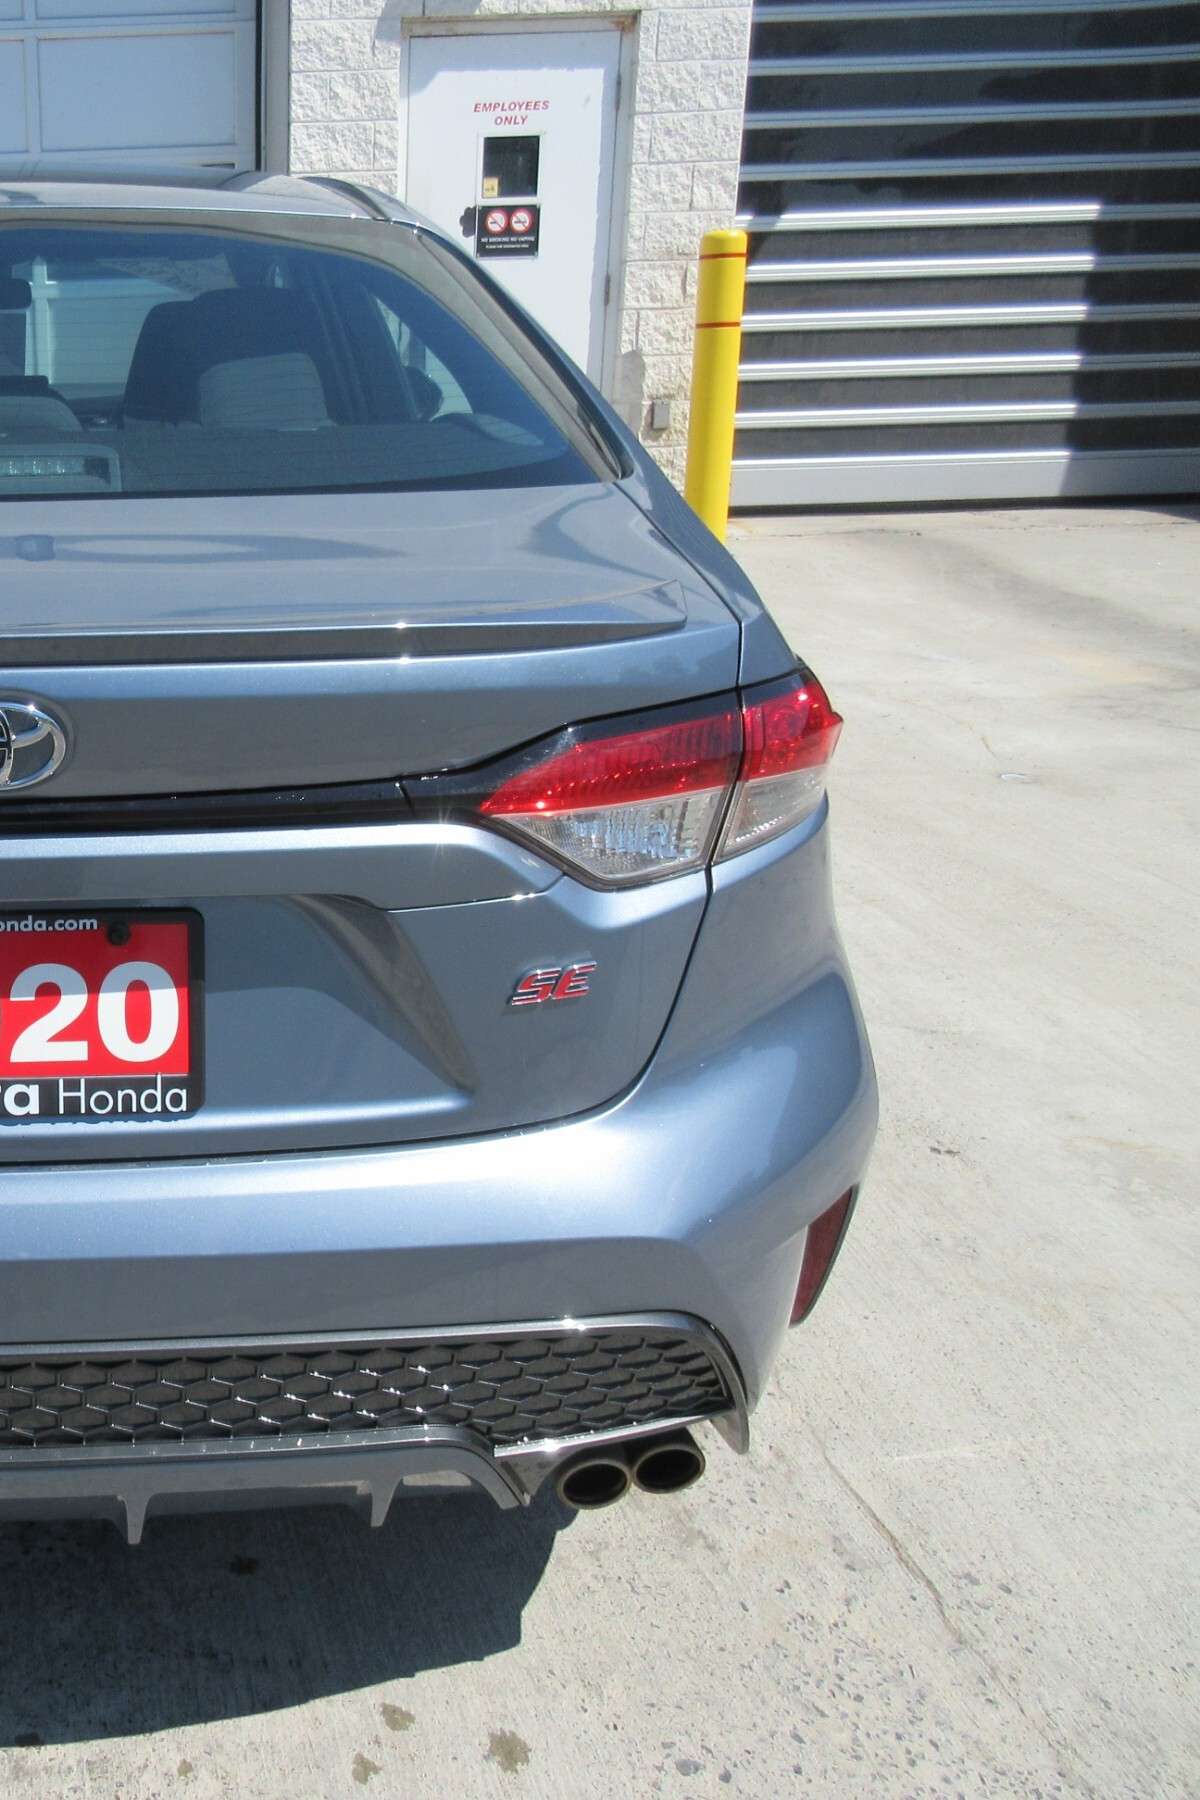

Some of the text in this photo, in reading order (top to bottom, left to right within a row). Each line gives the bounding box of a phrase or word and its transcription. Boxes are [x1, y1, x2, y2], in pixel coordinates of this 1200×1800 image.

[474, 100, 549, 113] EMPLOYEES
[494, 115, 528, 126] ONLY
[511, 960, 597, 1006] SE
[57, 1072, 188, 1115] Honda
